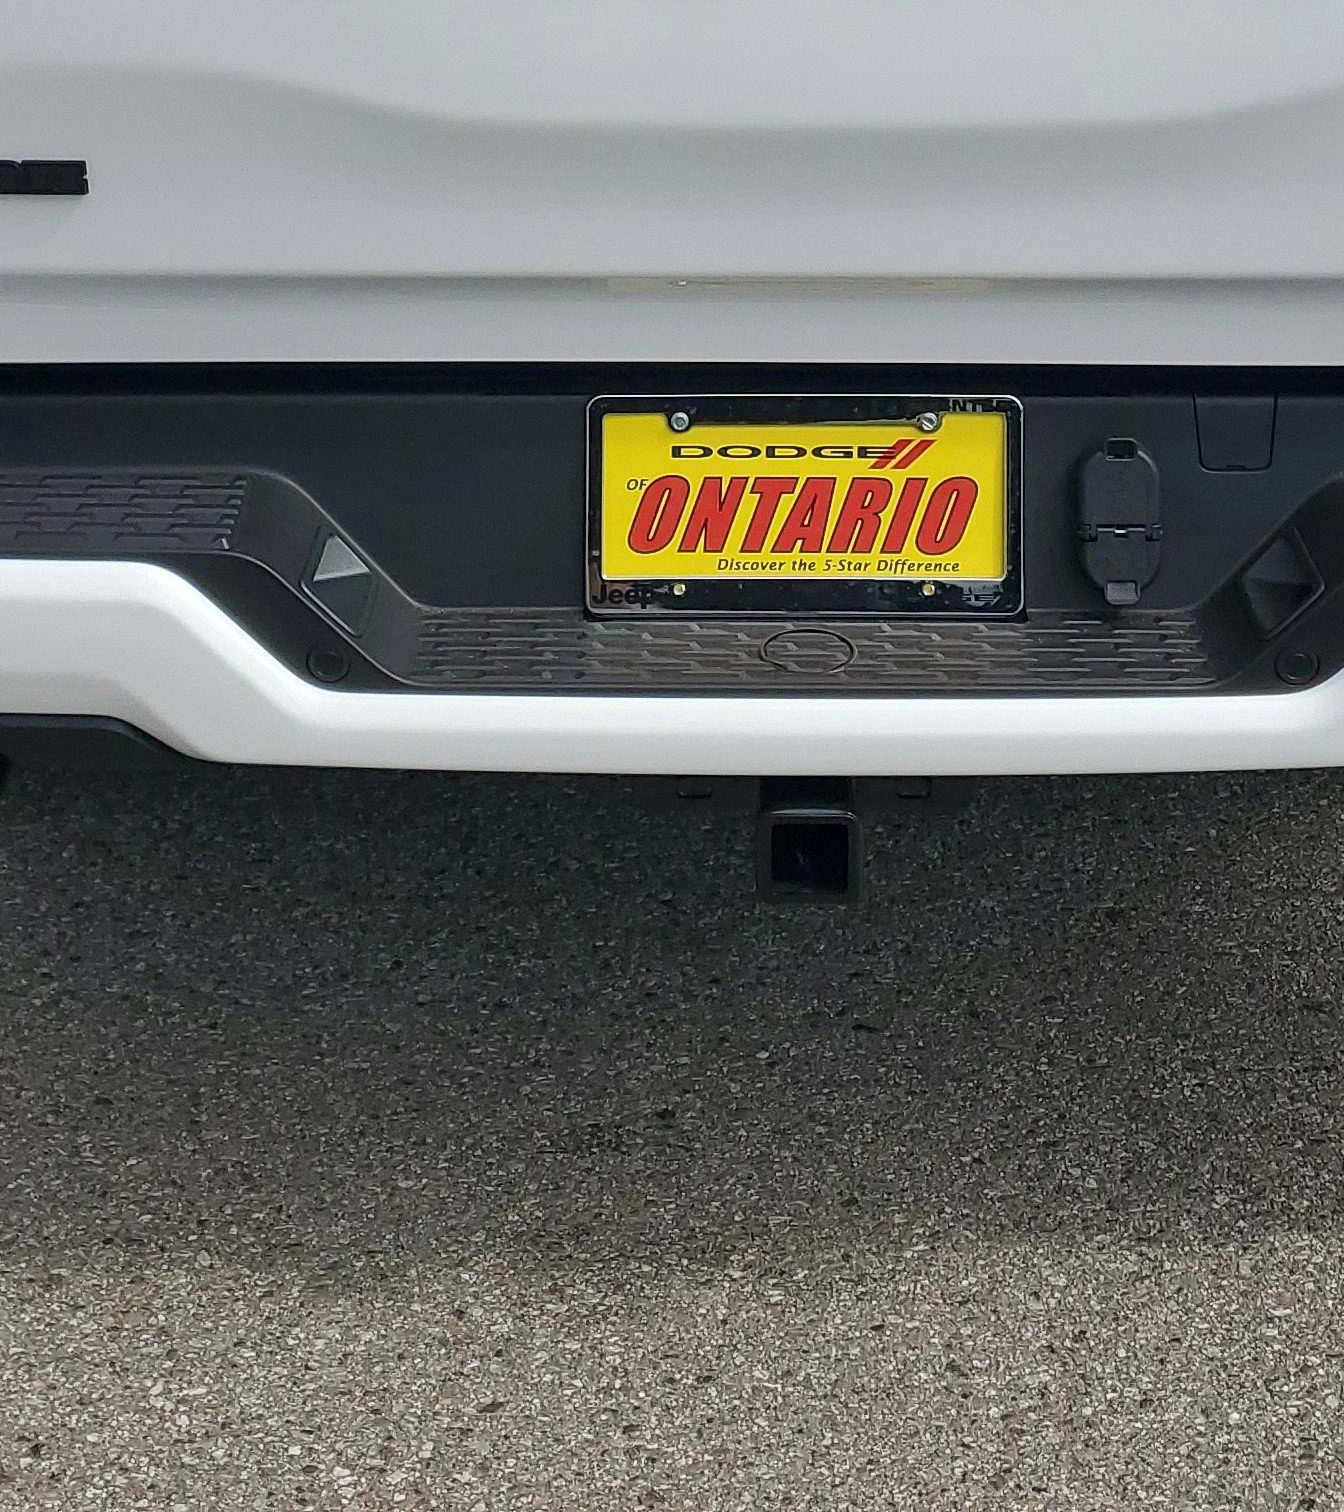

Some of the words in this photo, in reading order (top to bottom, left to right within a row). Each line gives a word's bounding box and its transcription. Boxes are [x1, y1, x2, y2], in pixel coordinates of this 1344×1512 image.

[670, 444, 897, 459] DODGE
[626, 478, 649, 492] OF
[627, 474, 979, 556] ONTARIO
[717, 557, 786, 572] Discover
[791, 558, 816, 572] the
[822, 558, 872, 572] 5-Star
[876, 558, 961, 575] Difference
[592, 582, 656, 610] Jeep
